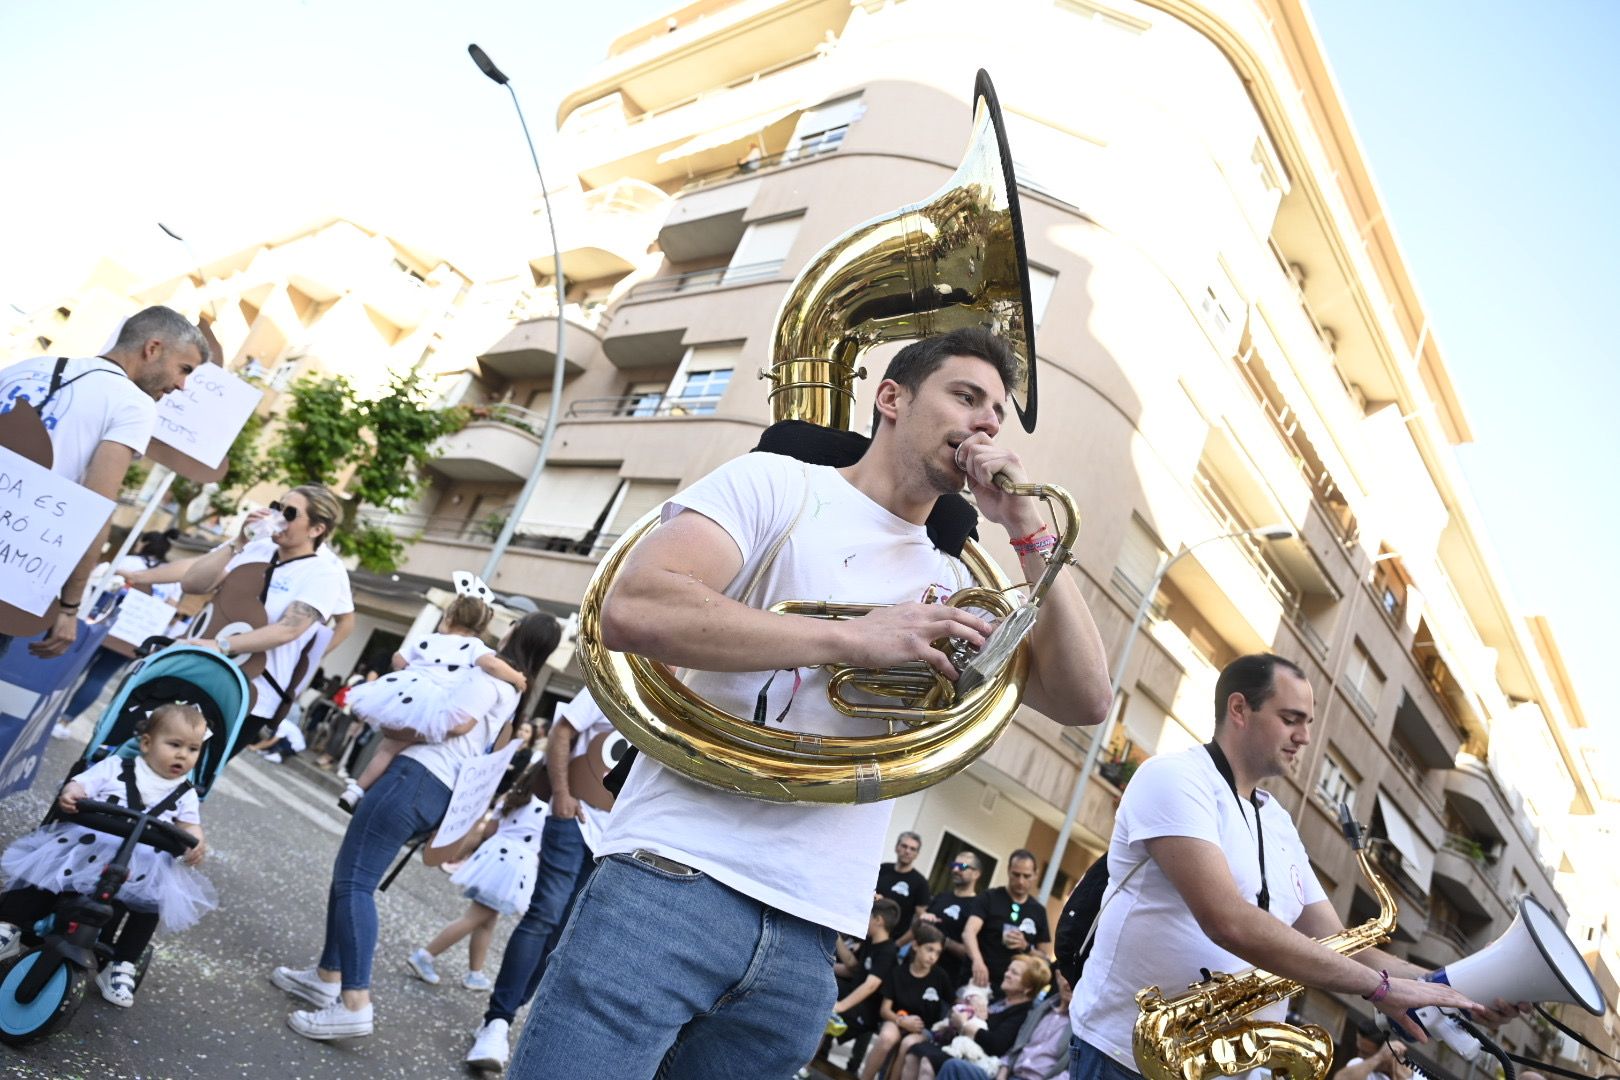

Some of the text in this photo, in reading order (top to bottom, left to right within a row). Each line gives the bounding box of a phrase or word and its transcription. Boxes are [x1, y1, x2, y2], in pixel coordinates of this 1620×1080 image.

[157, 414, 198, 444] TOTS
[34, 494, 67, 517] ES
[40, 528, 63, 548] LA
[0, 539, 57, 589] AMO!!
